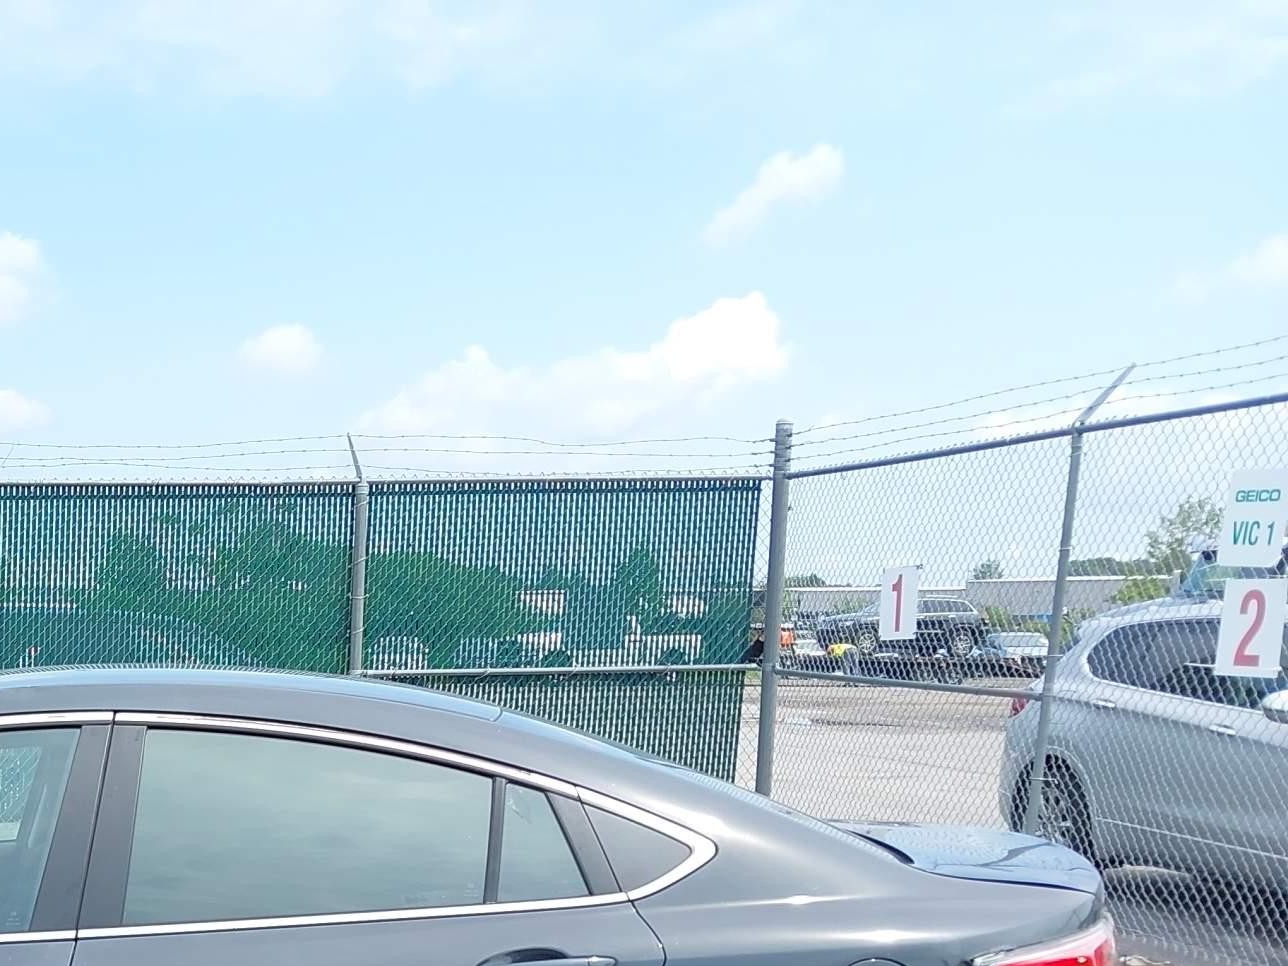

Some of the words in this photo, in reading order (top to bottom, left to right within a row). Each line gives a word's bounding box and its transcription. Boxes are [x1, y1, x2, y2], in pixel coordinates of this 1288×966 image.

[1235, 489, 1281, 503] GEICO
[1232, 520, 1261, 546] VIC
[1266, 521, 1276, 546] 1
[891, 573, 903, 633] 1
[1232, 588, 1267, 668] 2
